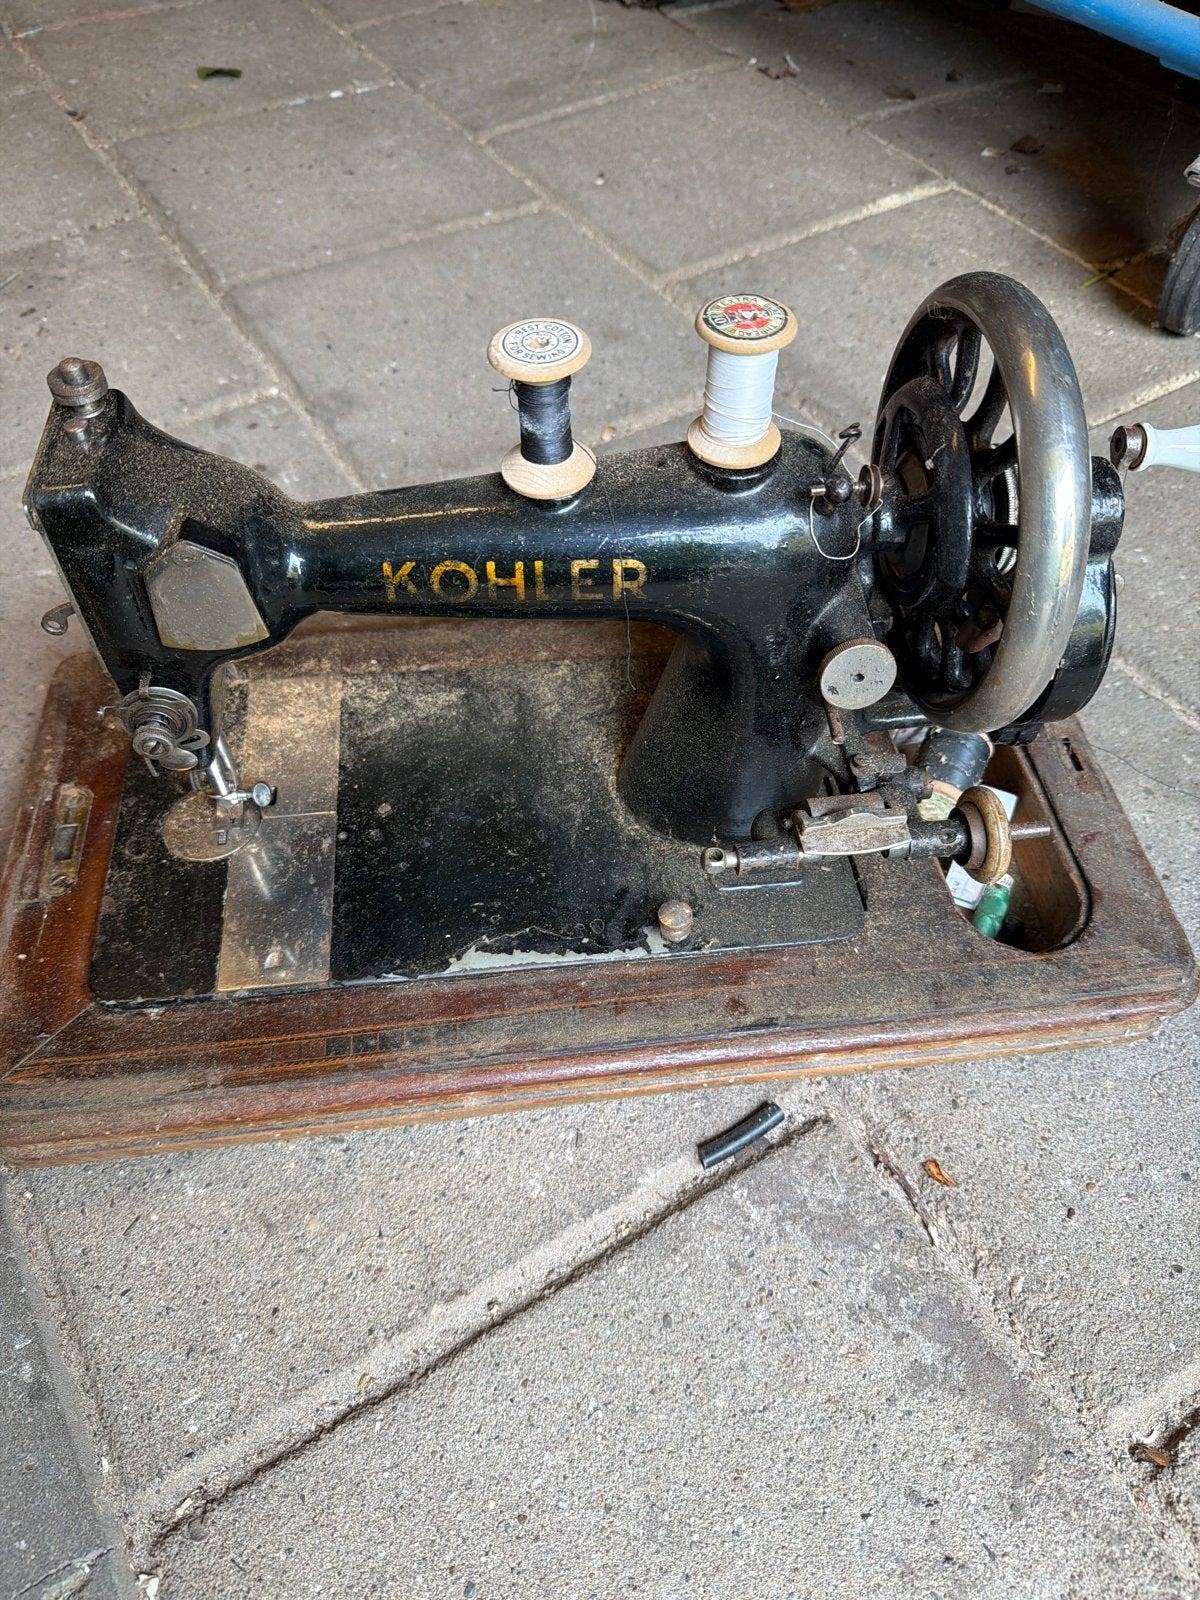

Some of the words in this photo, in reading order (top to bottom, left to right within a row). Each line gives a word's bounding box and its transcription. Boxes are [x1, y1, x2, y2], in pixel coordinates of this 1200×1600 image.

[514, 323, 541, 336] BEST
[543, 324, 573, 344] COTTON
[508, 341, 523, 355] FOR
[521, 349, 566, 361] SEWING
[382, 558, 649, 602] KOHLER
